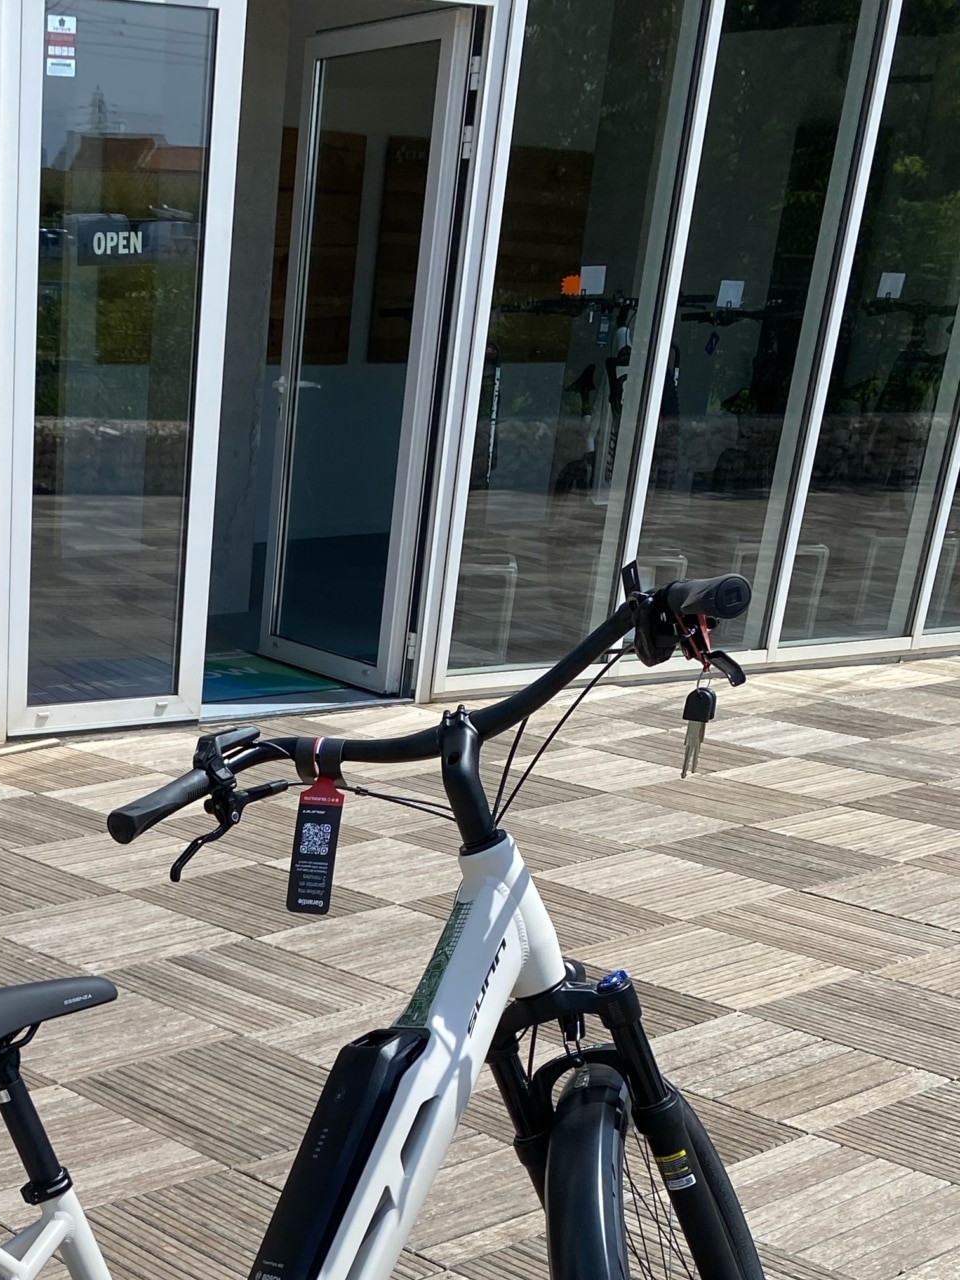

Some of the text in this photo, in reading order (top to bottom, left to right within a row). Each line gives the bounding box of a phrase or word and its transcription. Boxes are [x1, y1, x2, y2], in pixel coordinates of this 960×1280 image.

[92, 230, 143, 256] OPEN
[297, 898, 324, 907] Garantie
[63, 993, 93, 1005] ESSENZA
